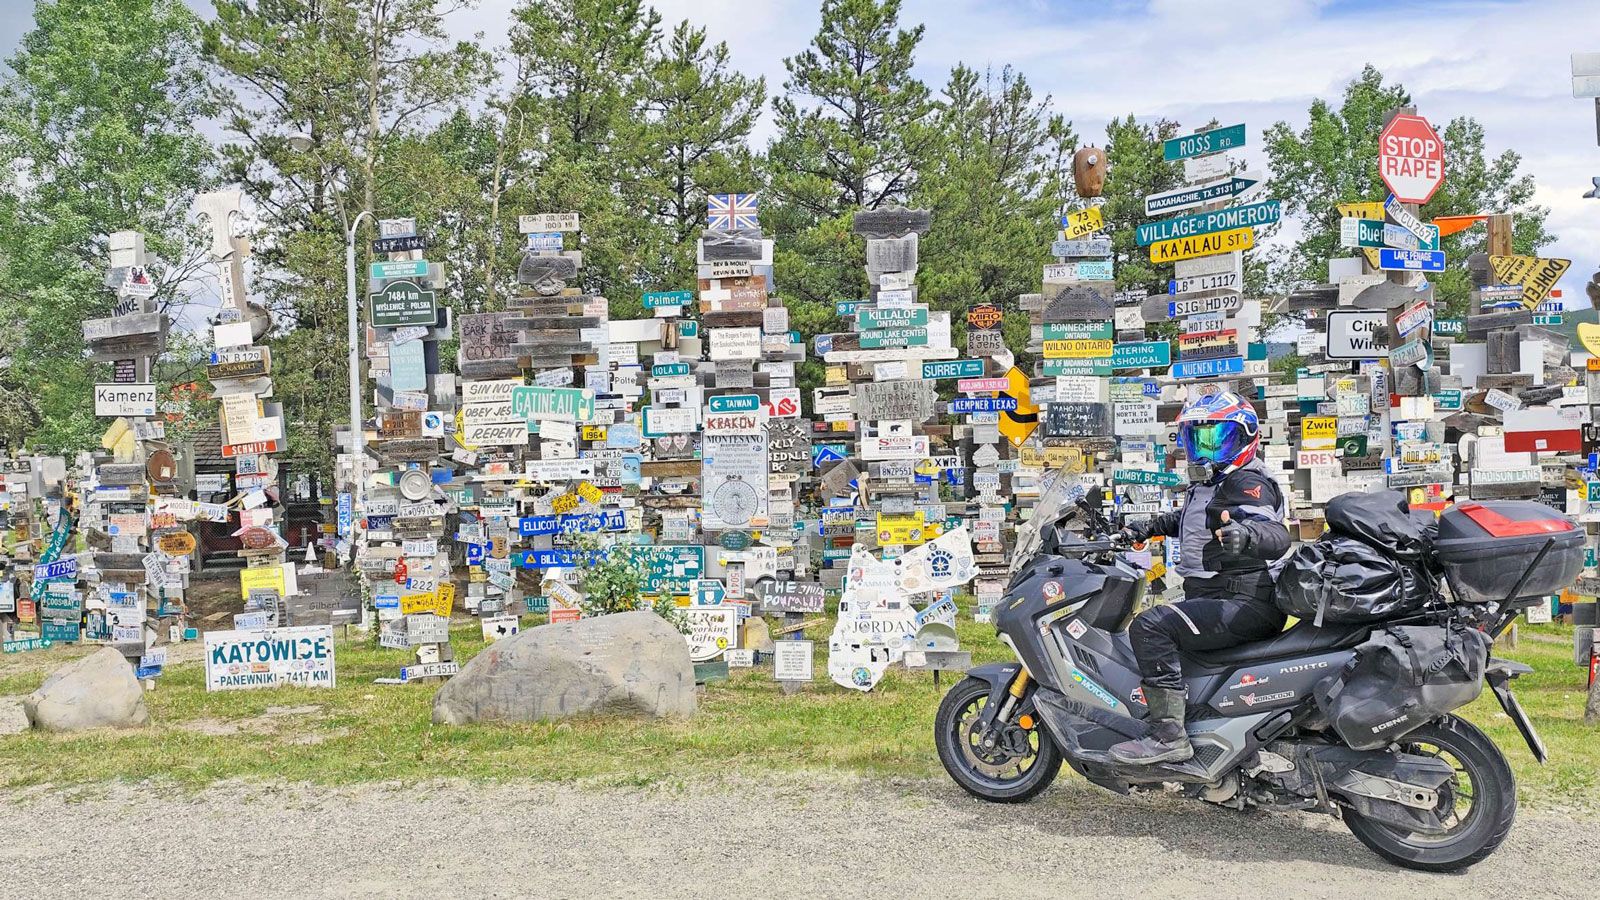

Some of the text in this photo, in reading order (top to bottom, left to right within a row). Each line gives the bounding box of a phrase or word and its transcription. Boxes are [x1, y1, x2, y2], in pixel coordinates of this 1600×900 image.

[1180, 134, 1233, 156] ROSS RD.
[1386, 135, 1436, 157] STOP
[1386, 159, 1437, 180] RAPE
[1149, 192, 1200, 209] WAXAHACHIE,
[1235, 182, 1245, 191] MI
[1076, 211, 1089, 222] 73
[1073, 219, 1101, 236] GNS-1
[1140, 205, 1276, 242] VILLAGE OF POMEROY
[1401, 212, 1414, 229] CU
[1412, 224, 1432, 242] 267
[1161, 235, 1240, 259] KA'ALAU ST
[1177, 281, 1188, 293] LB
[387, 291, 418, 300] 7484 km
[648, 295, 680, 306] Palmer
[1177, 301, 1199, 315] SIG
[868, 310, 917, 320] KILLALOE
[969, 312, 1000, 320] MIRO
[876, 319, 910, 327] ONTARIO
[1051, 322, 1104, 332] BONNECHERE
[1189, 322, 1203, 332] HOT
[1438, 322, 1462, 332] TEXAS
[884, 331, 901, 339] LAKE
[903, 329, 927, 338] CENTER
[969, 333, 1000, 341] Bente
[879, 338, 909, 346] ONTARIO
[1045, 341, 1111, 351] WILNO ONTARIO
[1114, 345, 1154, 354] NTERING
[243, 352, 259, 361] 129
[1055, 359, 1062, 367] OF
[1182, 361, 1233, 375] NUENEN C.A.
[655, 365, 687, 375] IOLA WI
[924, 363, 962, 377] SURREY
[1061, 367, 1094, 375] ONTARIO
[471, 383, 516, 395] SIN NOT
[98, 389, 153, 402] Kamenz
[517, 392, 574, 414] GATINEAU
[726, 399, 752, 408] TAIWAN
[955, 398, 1016, 410] KEMPNER TEXAS
[467, 407, 492, 418] OBEY
[707, 416, 756, 430] KRAKÓW
[474, 428, 527, 439] REPENT
[707, 434, 763, 444] MONTESANO
[879, 437, 911, 446] SIGNS
[934, 457, 957, 466] XWR
[1300, 453, 1336, 465] BREY
[1115, 470, 1143, 482] LUMBY,
[1145, 474, 1156, 482] BC
[1474, 470, 1512, 482] MADISON
[170, 502, 191, 510] MOOSE
[540, 554, 558, 564] BILL
[652, 566, 661, 574] to
[412, 580, 433, 591] 222
[762, 581, 796, 593] THE
[309, 601, 340, 611] Gilbert
[852, 620, 917, 633] JORDAN
[691, 635, 715, 643] Gifts
[3, 641, 30, 652] RAPIDAN
[287, 670, 329, 683] 7417 KM
[1082, 679, 1116, 707] MOTOREX
